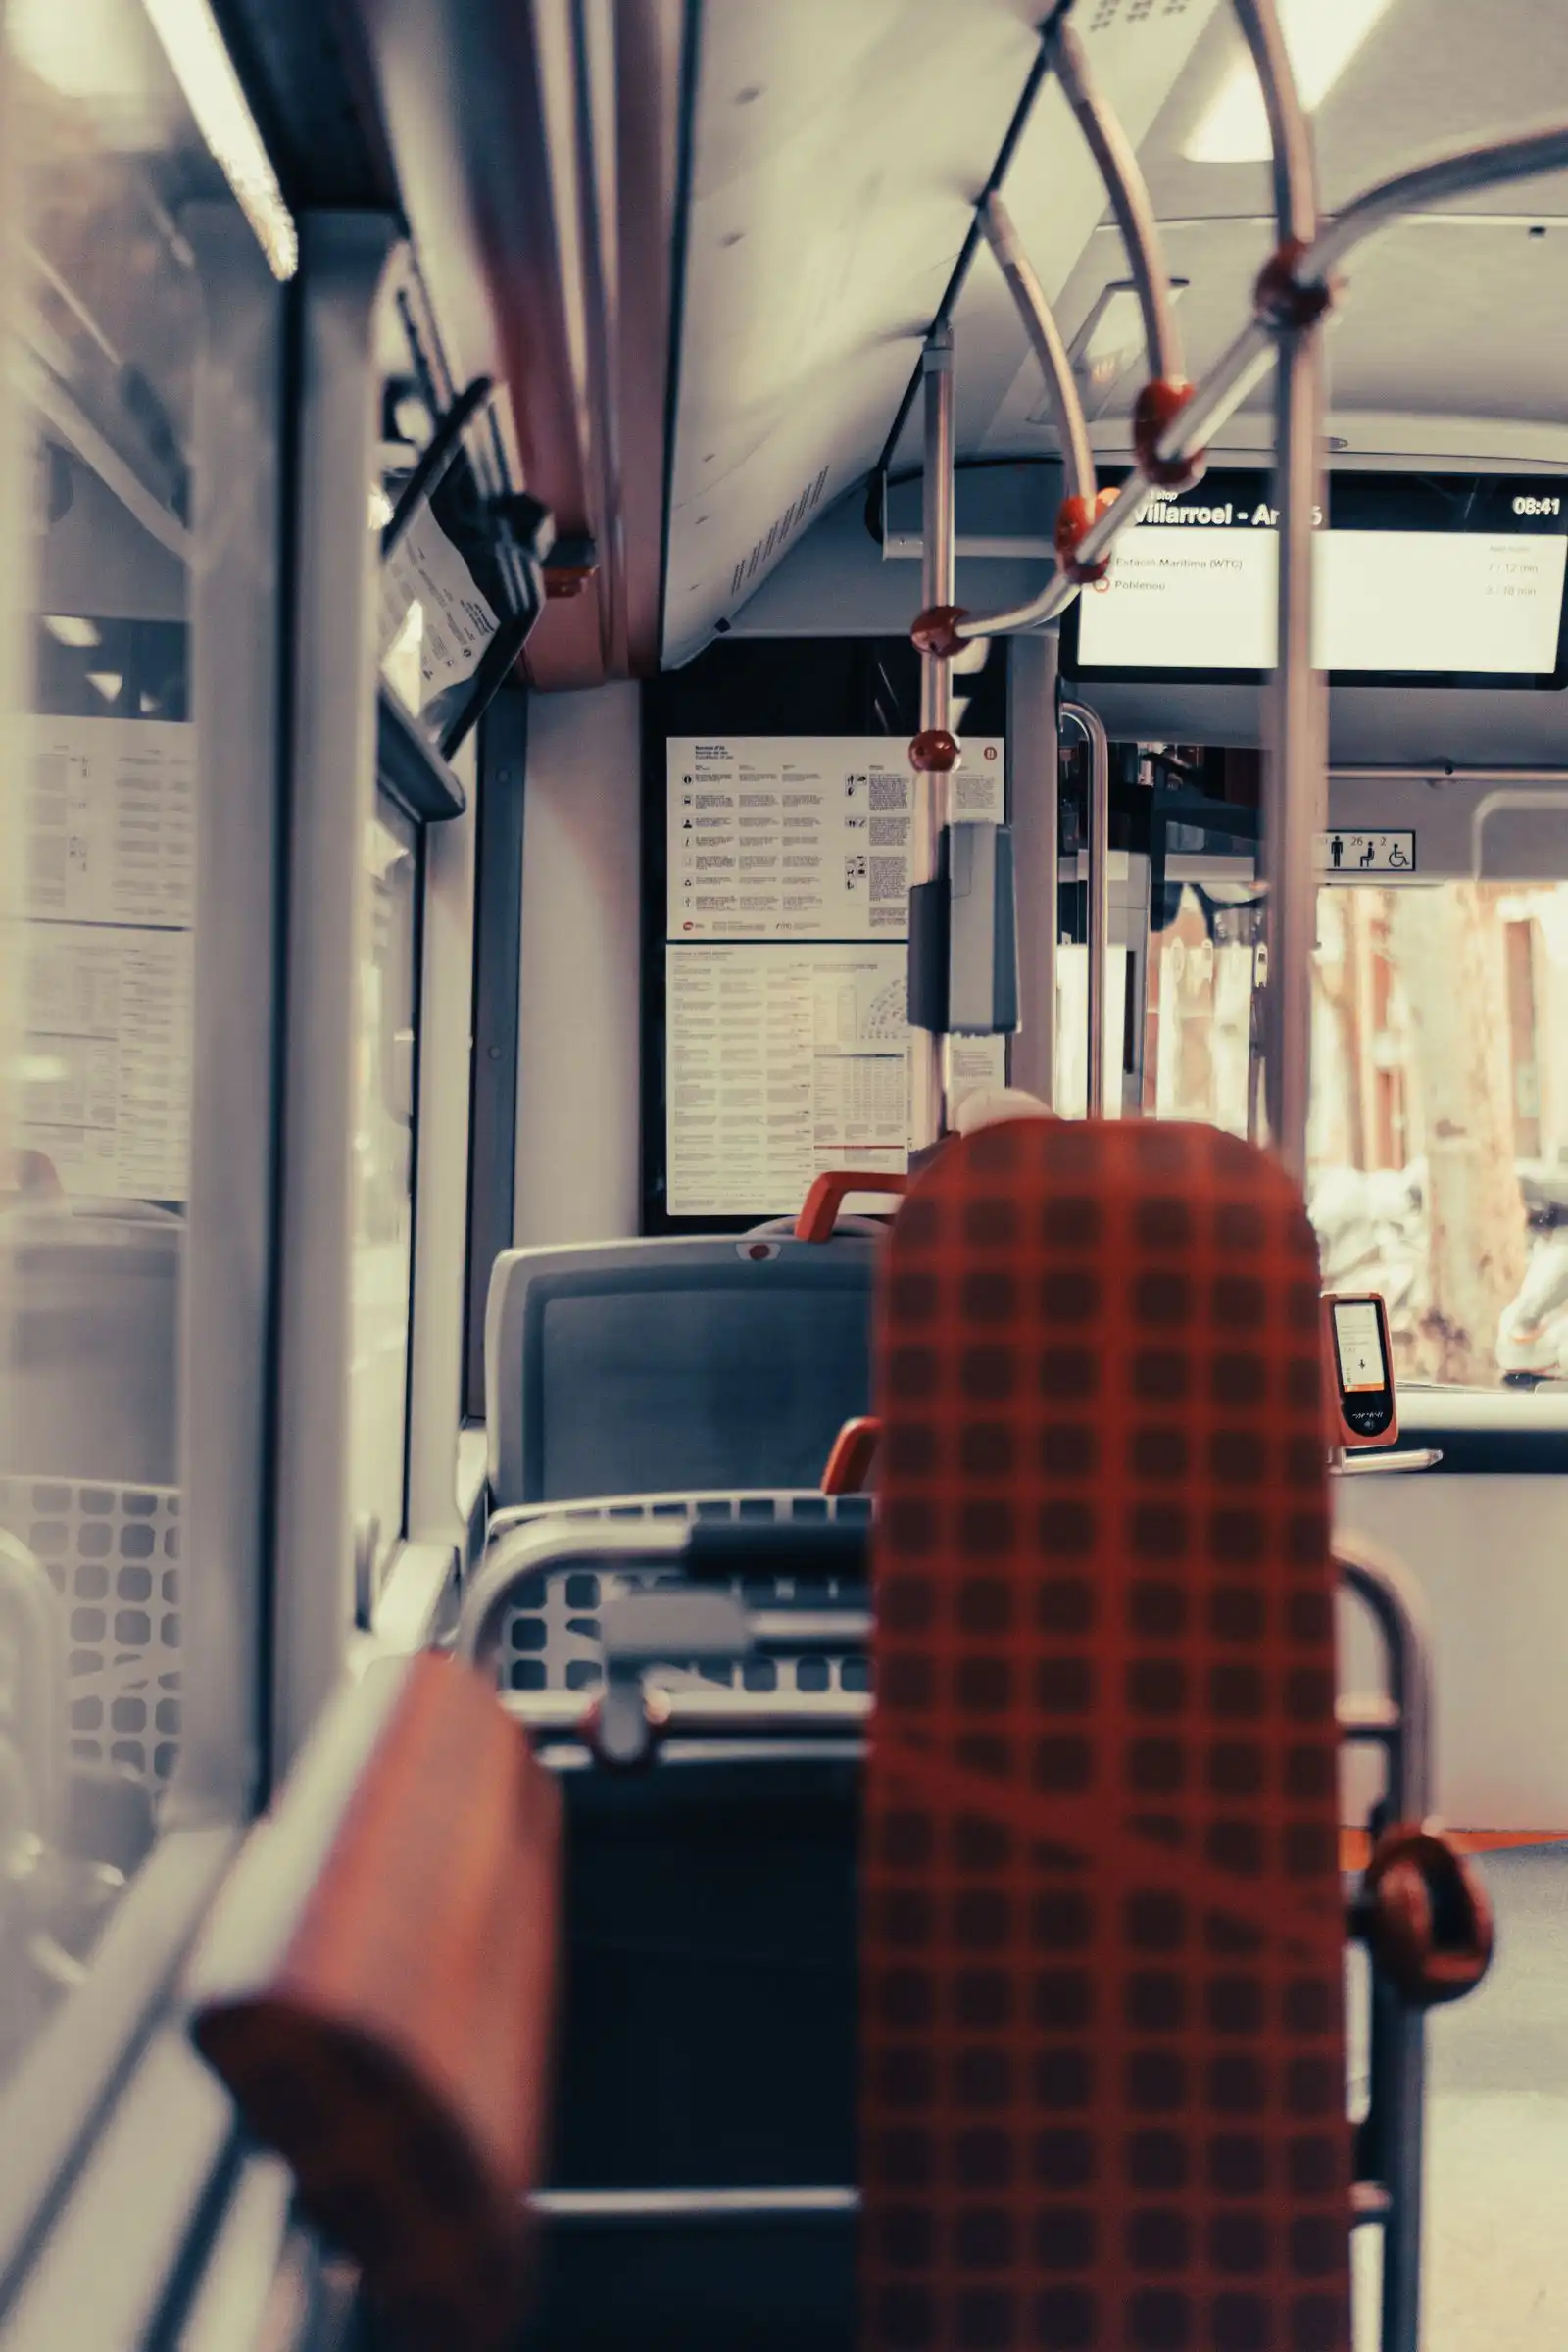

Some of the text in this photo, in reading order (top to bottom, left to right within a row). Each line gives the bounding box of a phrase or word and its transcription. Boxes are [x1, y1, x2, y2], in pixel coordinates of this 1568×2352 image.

[1513, 498, 1560, 514] 08:41
[1135, 503, 1232, 525] Villarroel
[1209, 559, 1243, 570] (WTC)
[1114, 580, 1166, 591] Poblenou
[1351, 836, 1388, 847] 26 2
